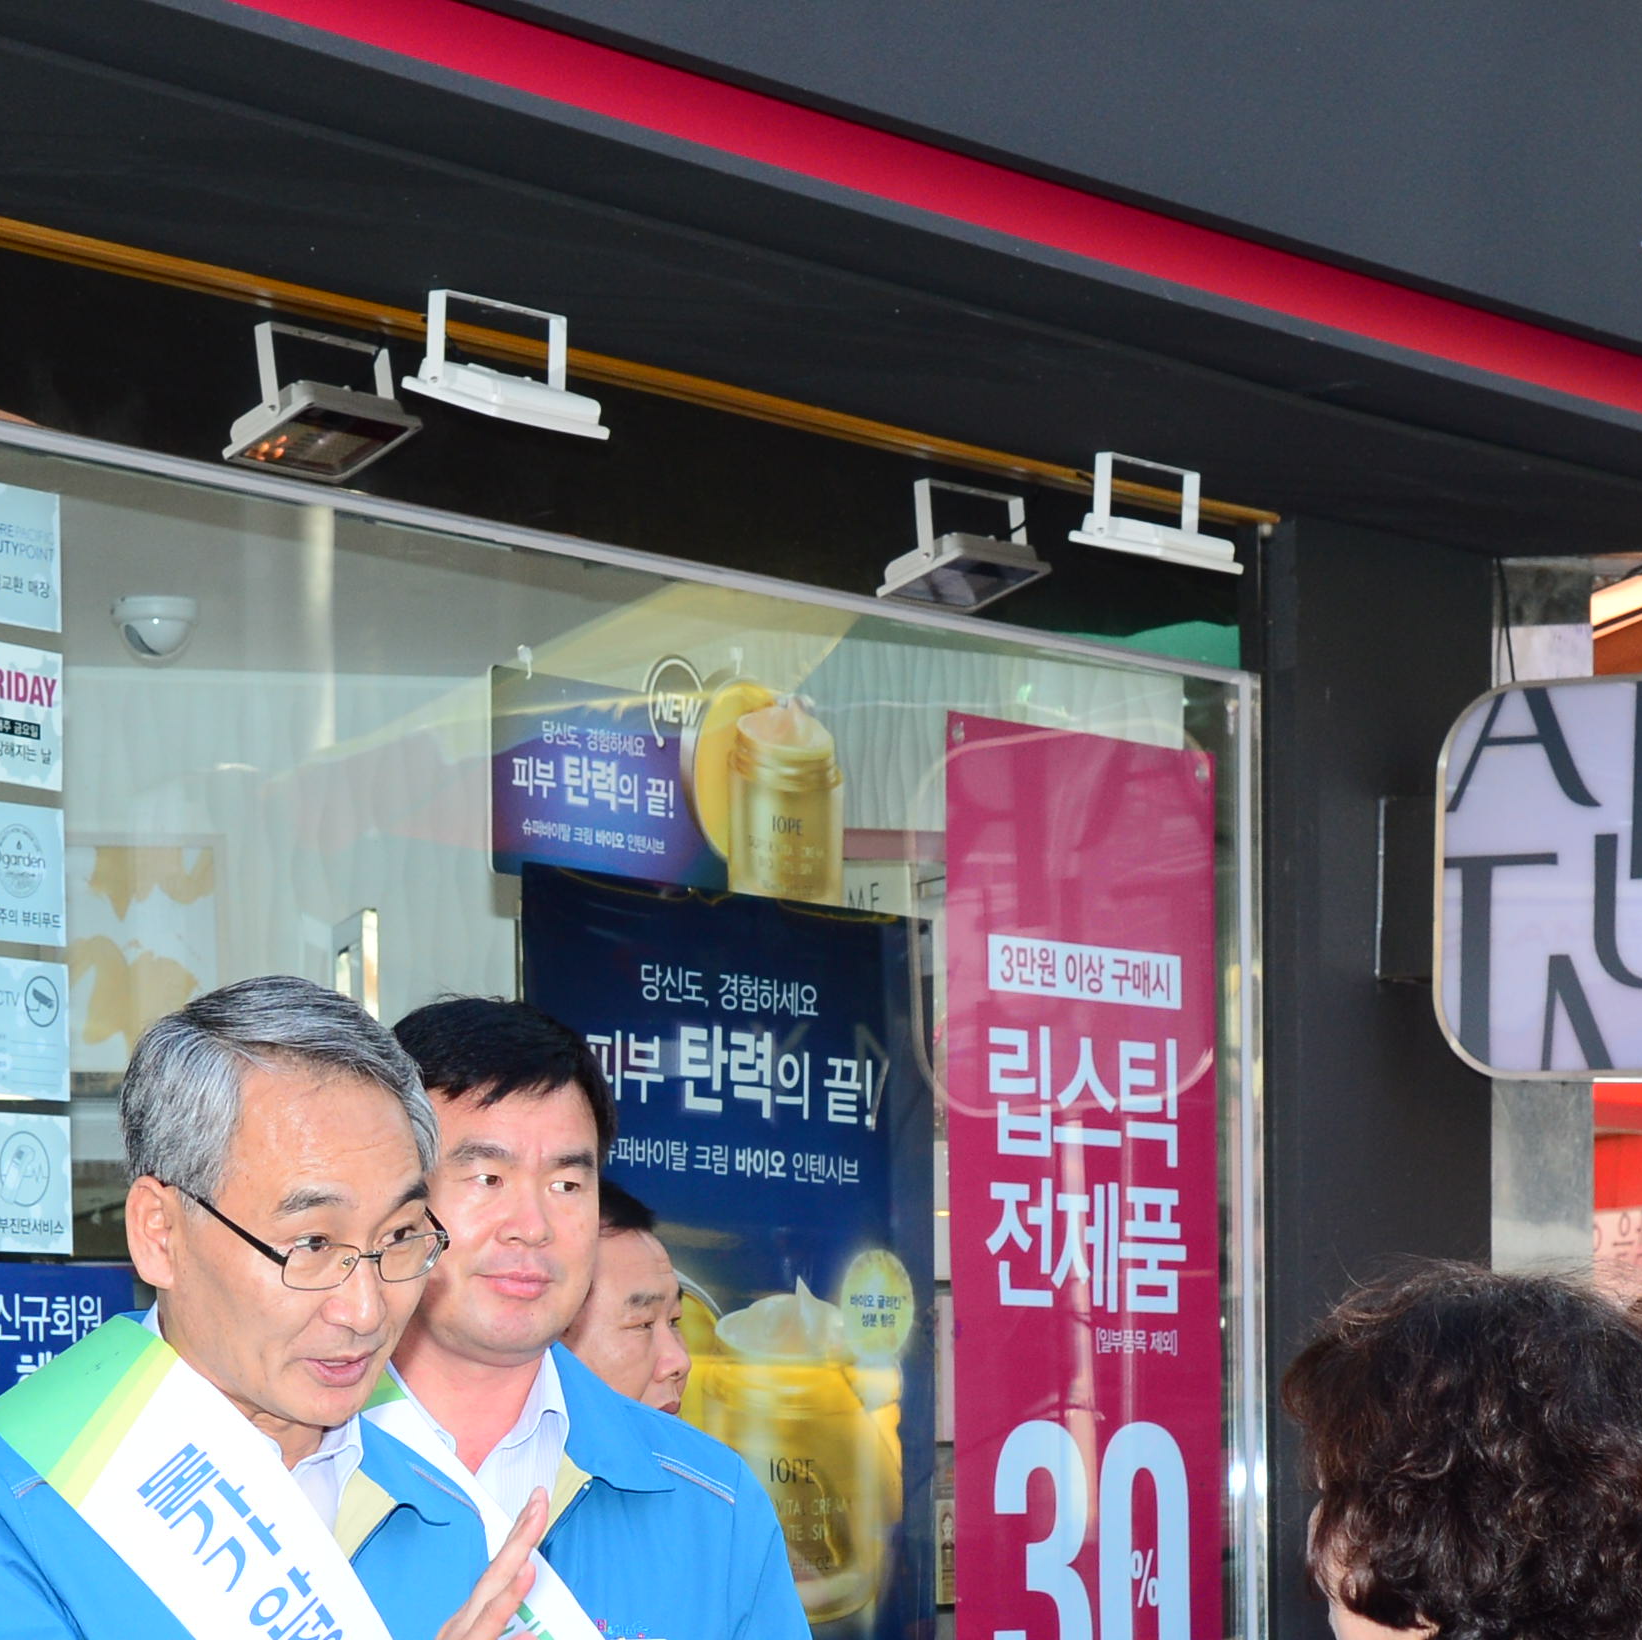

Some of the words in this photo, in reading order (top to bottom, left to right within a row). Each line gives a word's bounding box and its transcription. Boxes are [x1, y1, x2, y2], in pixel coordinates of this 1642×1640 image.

[655, 691, 701, 727] NEW
[14, 722, 39, 738] 금요일
[542, 719, 582, 752] 당신도,
[586, 728, 645, 759] 경험하세요
[41, 749, 52, 765] 날
[511, 754, 557, 793] 피부
[562, 753, 640, 815] 탄력의
[645, 774, 675, 820] 끝!
[522, 820, 571, 845] 슈퍼바이탈
[573, 825, 593, 846] 크림
[596, 830, 625, 851] 바이오
[627, 832, 665, 856] 인텐시브
[772, 815, 803, 836] IOPE
[22, 912, 61, 928] 뷰티푸드
[639, 963, 710, 1008] 당신도,
[718, 972, 819, 1018] 경험하세요
[1000, 944, 1057, 986] 3만원
[1065, 953, 1105, 993] 이상
[1110, 960, 1172, 1002] 구매시
[586, 1030, 664, 1103] 피부
[679, 1026, 811, 1120] 탄력의
[823, 1055, 876, 1130] 끝!
[988, 1026, 1181, 1168] 립스틱
[693, 1143, 729, 1176] 크림
[735, 1148, 786, 1181] 바이오
[792, 1151, 859, 1188] 인텐시브
[986, 1181, 1188, 1316] 전제품
[849, 1294, 873, 1309] 바이오
[770, 1458, 815, 1484] IOPE
[136, 1441, 282, 1592] 물가가
